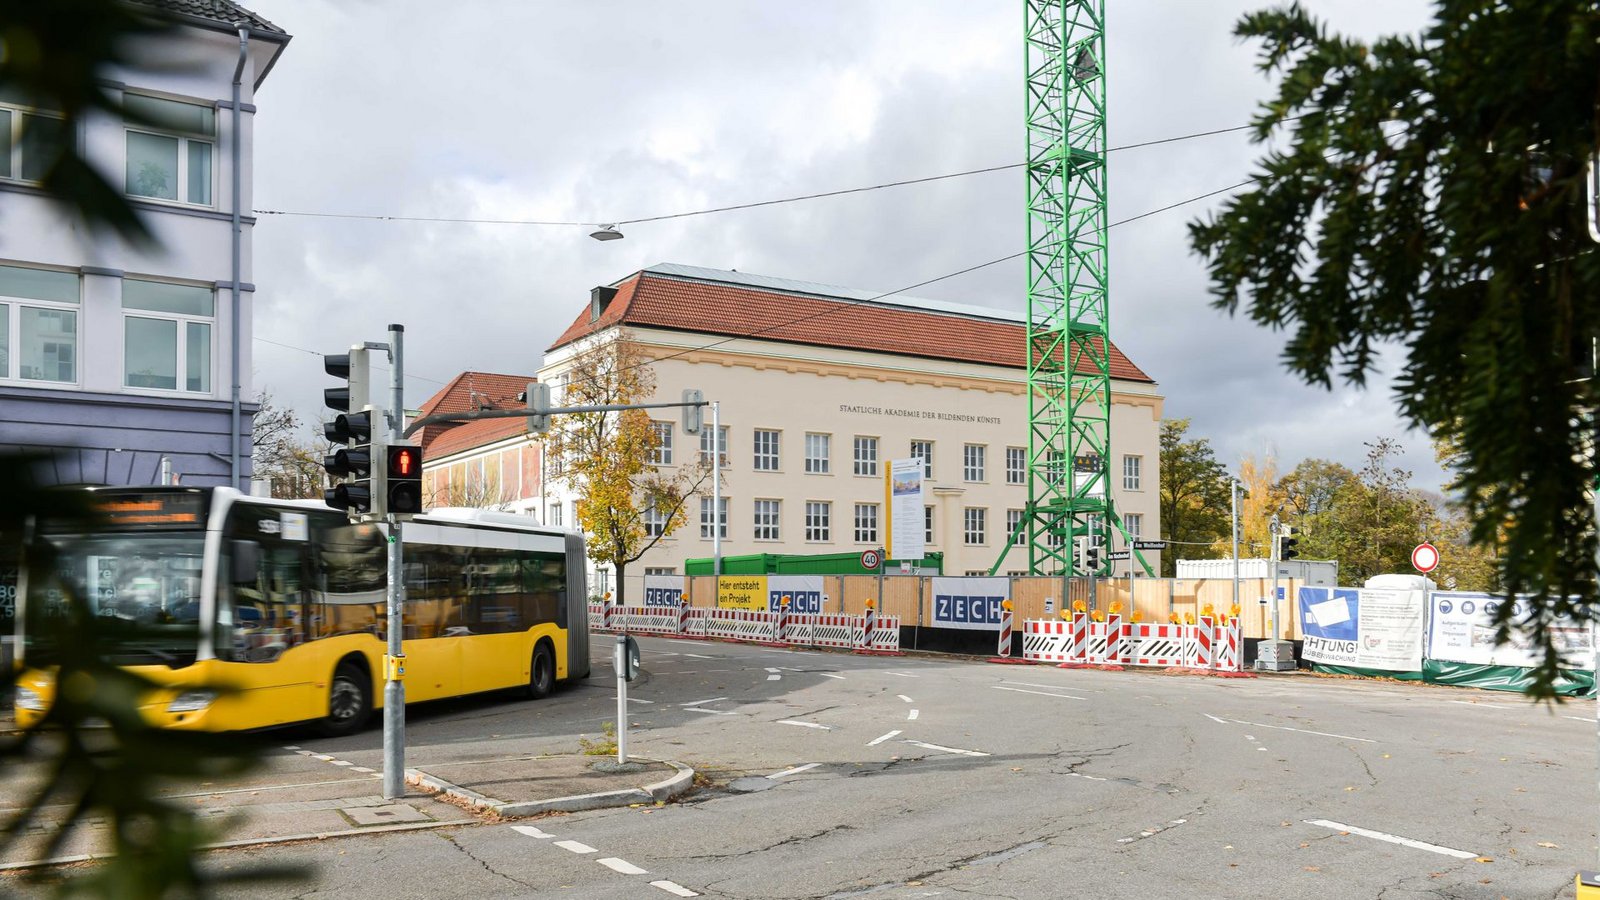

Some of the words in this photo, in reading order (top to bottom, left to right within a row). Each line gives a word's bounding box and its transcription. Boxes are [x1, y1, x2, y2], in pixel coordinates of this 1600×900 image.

[839, 404, 882, 415] STAATLICHE
[884, 408, 920, 418] AKADEMIE
[922, 411, 936, 419] DER
[937, 413, 975, 422] BILDENDEN
[977, 415, 1001, 425] KÜNSTE
[864, 554, 876, 564] 40
[719, 580, 732, 590] Hier
[733, 581, 760, 590] entsteht
[647, 590, 681, 606] ZECH
[719, 594, 728, 603] ein
[728, 593, 751, 605] Projekt
[771, 594, 818, 611] ZCH
[939, 599, 1002, 619] ZECH
